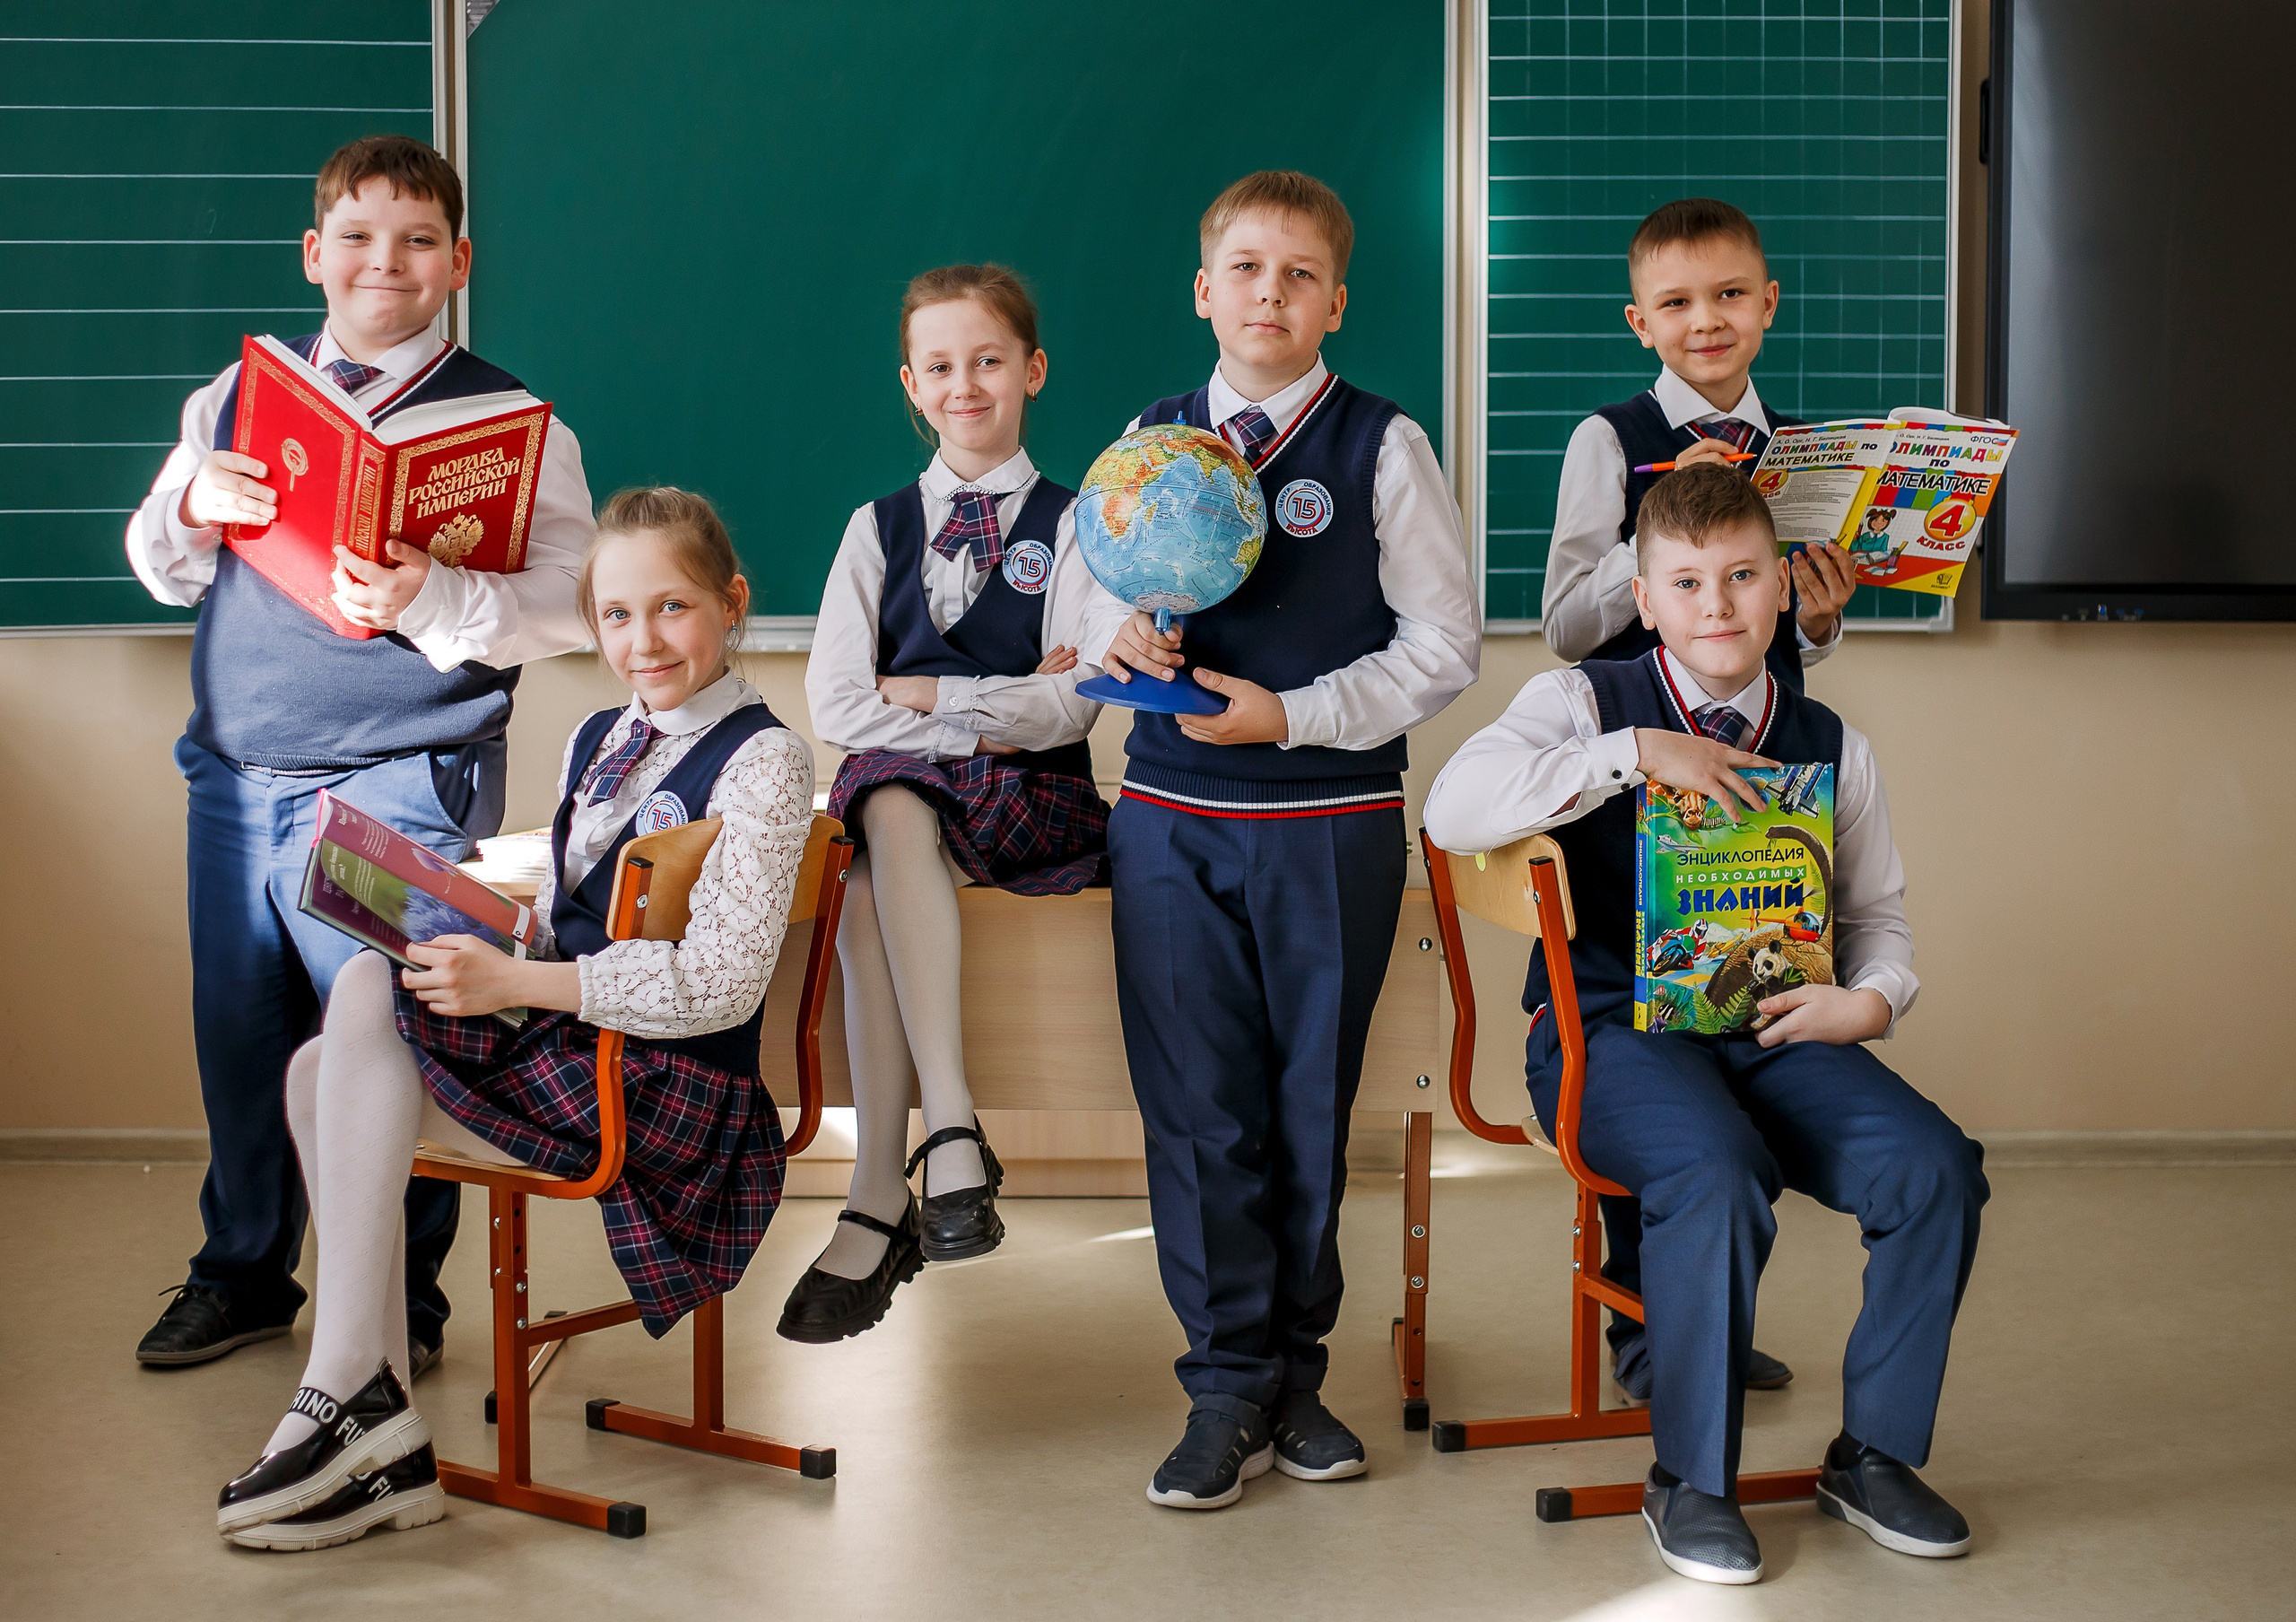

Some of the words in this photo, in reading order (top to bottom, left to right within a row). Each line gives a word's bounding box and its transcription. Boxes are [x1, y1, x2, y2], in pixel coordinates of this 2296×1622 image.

[1771, 440, 1857, 455] ОЛИМПИАДЫ
[1970, 435, 1999, 445] ФГОС
[1764, 452, 1856, 467] МАТЕМАТИКЕ
[408, 457, 520, 505] РОССИЙСКОЙ
[1759, 472, 1783, 490] 4
[416, 478, 507, 519] ИМПЕРИИ
[1278, 487, 1291, 509] ЦЕНТР
[1761, 491, 1780, 499] АСС
[1292, 497, 1317, 519] 15
[1285, 523, 1318, 536] ВЫСОТА
[1929, 504, 1965, 536] 4
[354, 513, 370, 556] СИЙСКОЙ
[1917, 536, 1965, 551] КЛАСС
[1004, 547, 1017, 566] ЦЕНТР
[1019, 556, 1041, 577] 15
[1013, 579, 1041, 592] ВЫСОТА
[639, 798, 653, 818] ЦЕНТР
[665, 794, 686, 824] ОБРАЗОВАН
[652, 808, 673, 831] 15
[1676, 848, 1805, 866] ЭНЦИКЛОПЕДИЯ
[1675, 868, 1805, 884] НЕОБХОДИМЫХ
[1676, 877, 1805, 915] ЗНАНИЙ
[335, 1416, 366, 1446] FU
